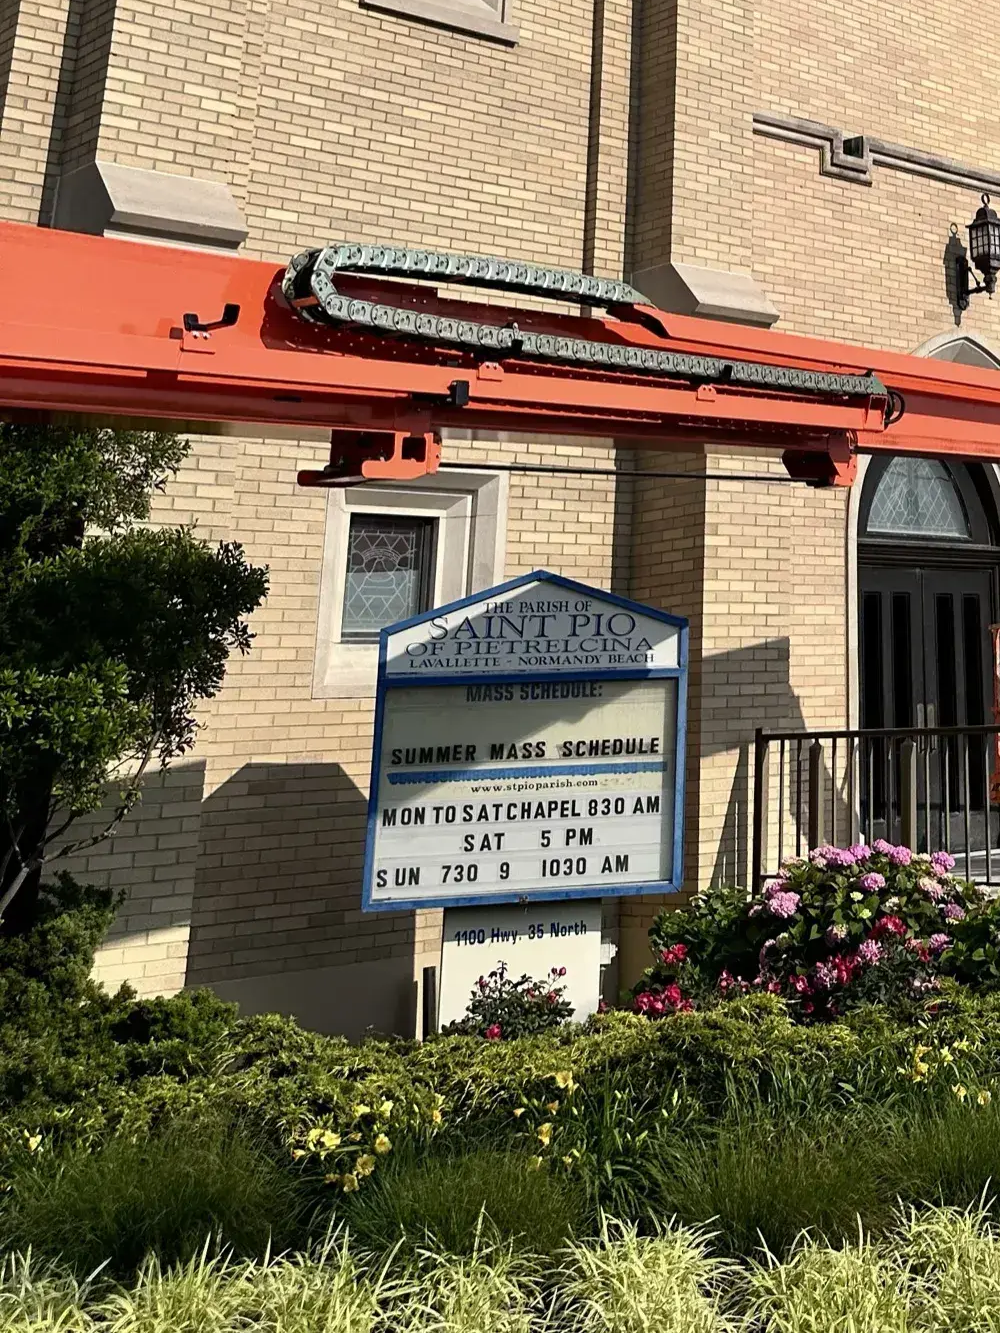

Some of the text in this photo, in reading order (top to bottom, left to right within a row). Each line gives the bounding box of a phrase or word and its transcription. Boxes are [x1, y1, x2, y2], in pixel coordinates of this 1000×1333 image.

[483, 599, 593, 614] THE PARISH OF
[428, 612, 637, 641] SAINT PIO
[405, 637, 655, 657] OF PIETRELCINA
[409, 656, 500, 668] LAVALLETTE
[518, 654, 603, 666] NORMANDY
[609, 653, 655, 664] BEACH
[466, 682, 602, 702] MASS SCHEDULE:
[391, 737, 660, 765] SUMMER MASS SCHEDULE
[471, 778, 598, 794] www.stpioparish.com
[382, 807, 426, 827] MON
[433, 805, 456, 824] TO
[588, 797, 625, 816] 830
[632, 796, 660, 815] AM
[463, 828, 593, 852] SAT 5 PM
[376, 854, 629, 888] SUN 730 9 1030 AM
[454, 920, 587, 947] 1100 Hwy. 35 North
